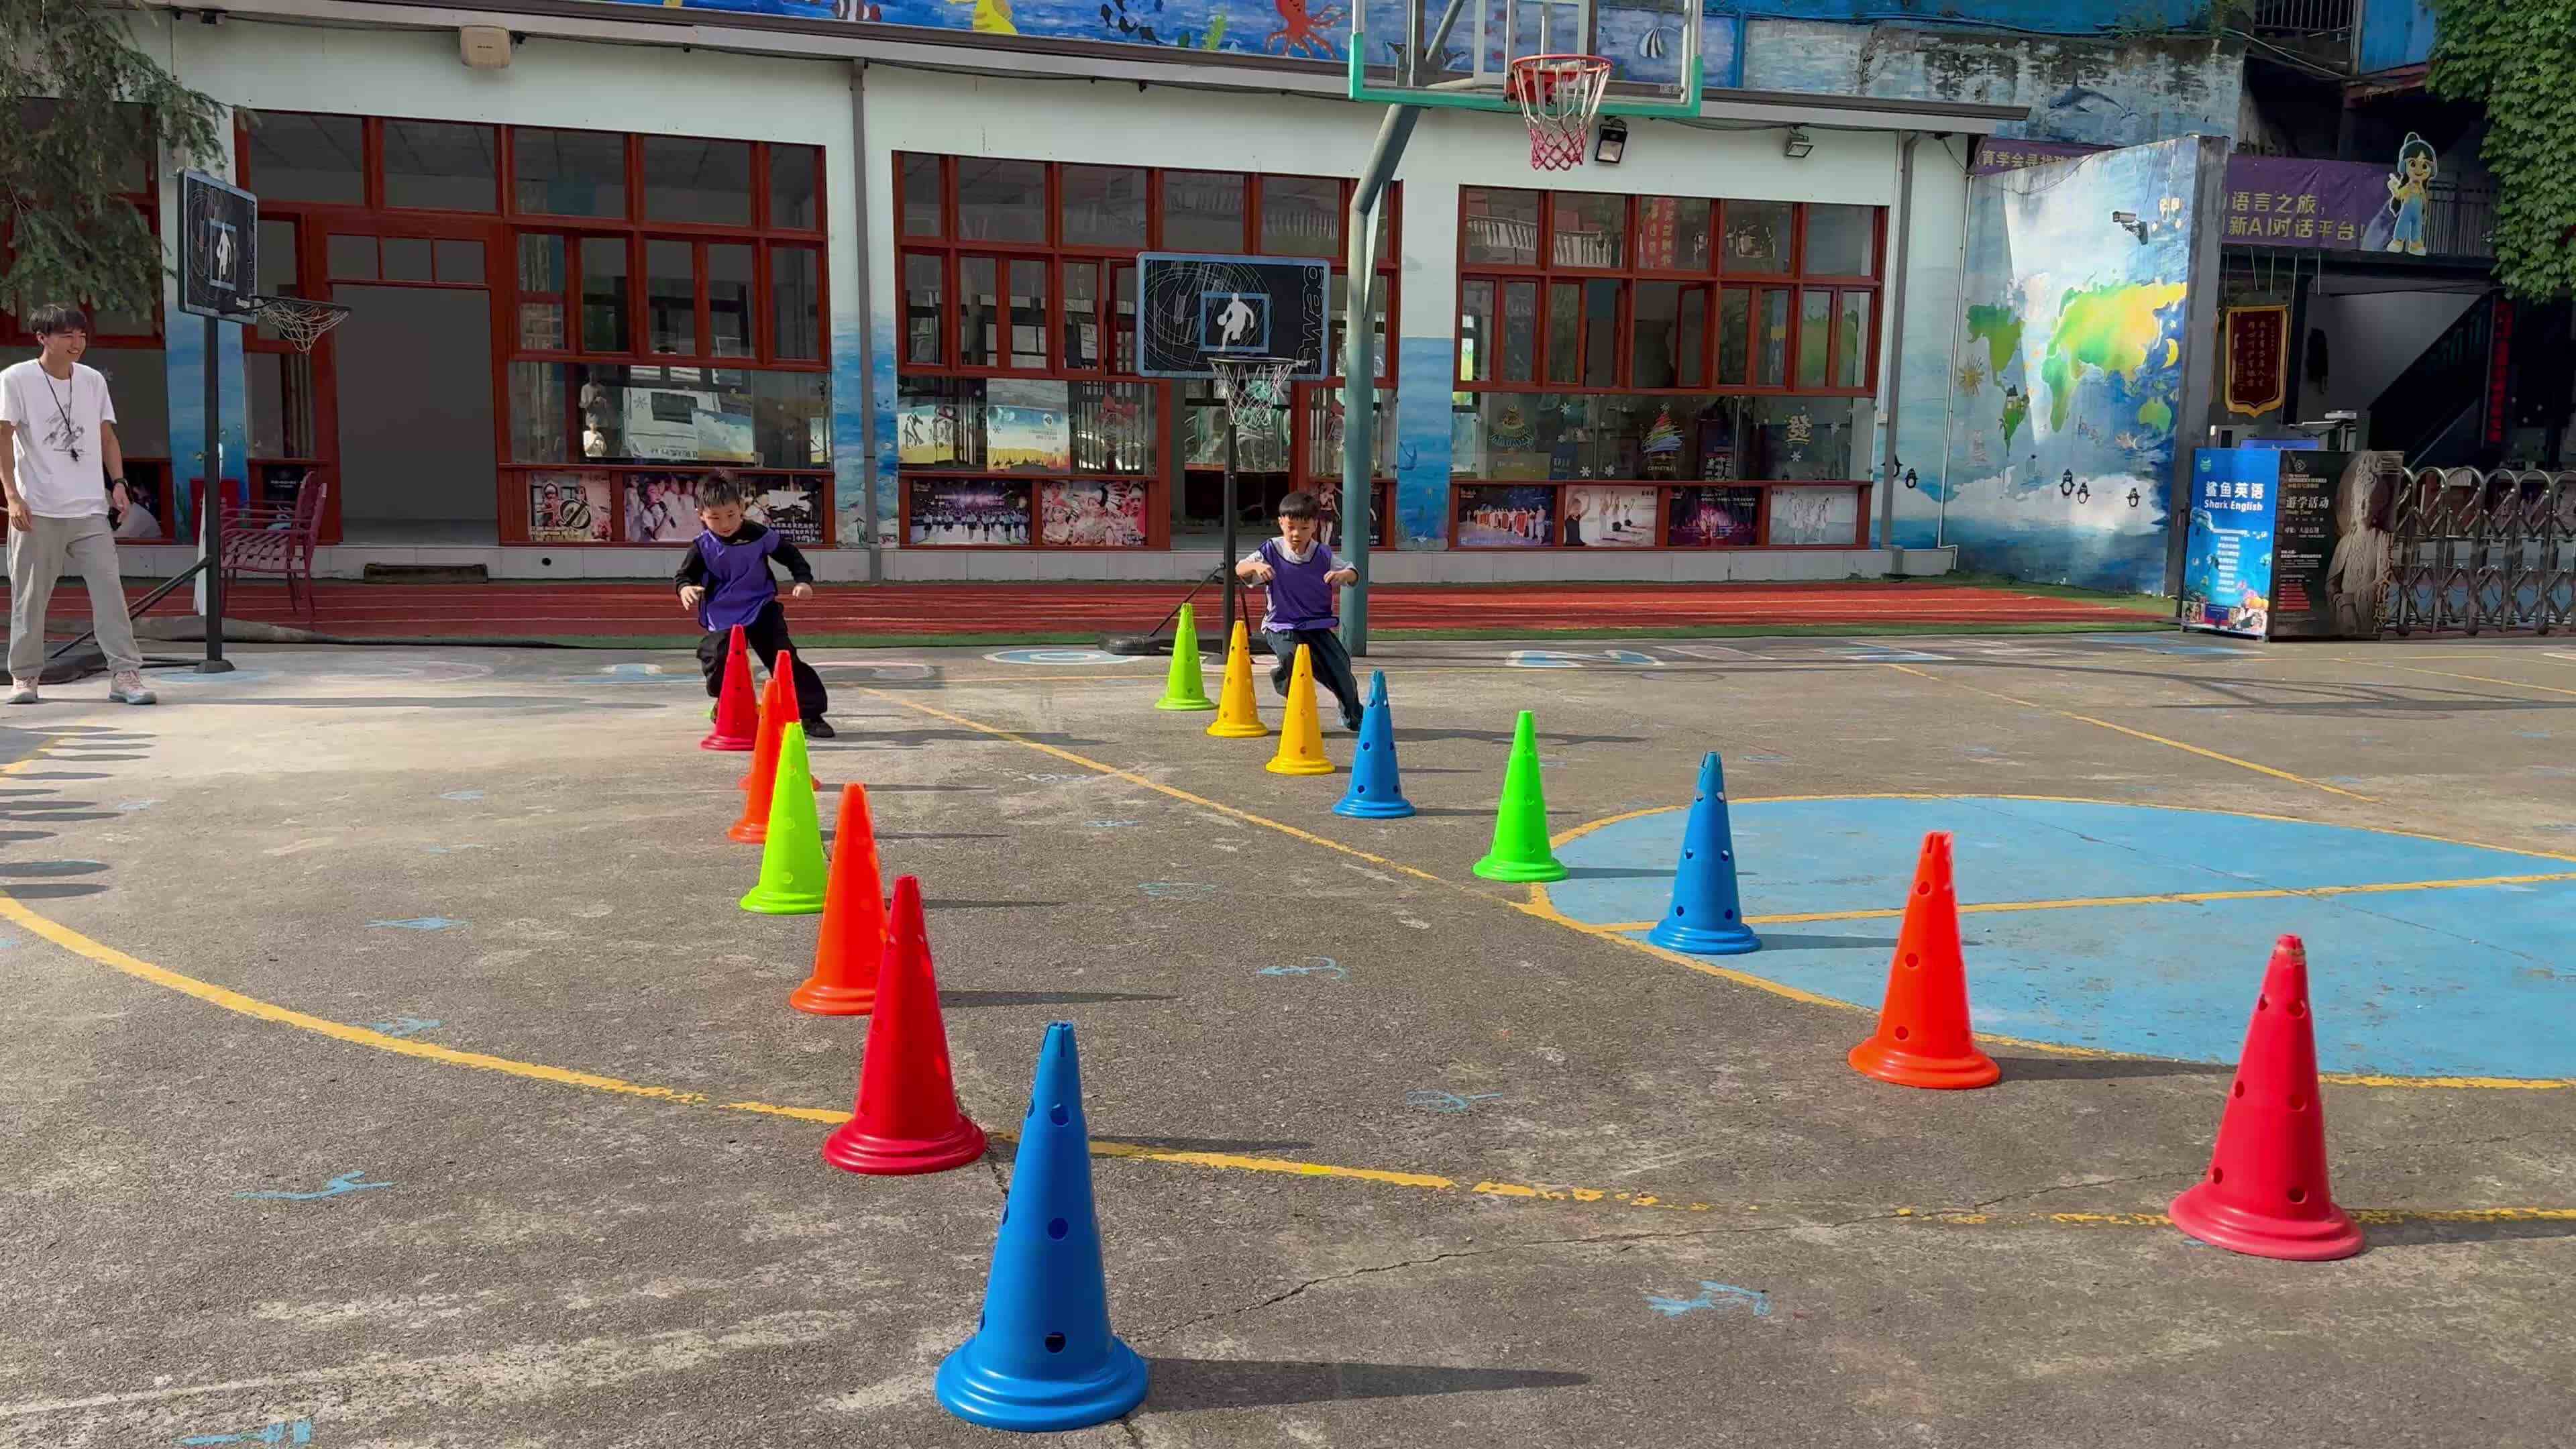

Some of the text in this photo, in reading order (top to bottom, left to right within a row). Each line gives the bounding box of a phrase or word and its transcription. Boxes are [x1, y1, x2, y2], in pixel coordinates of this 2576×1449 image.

[2223, 191, 2324, 215] 语言之旅，
[2222, 215, 2365, 241] 新AI对话平台！
[2205, 481, 2265, 500] 鲨鱼英语
[2204, 499, 2263, 513] Shark English
[2286, 496, 2330, 509] 游学活动
